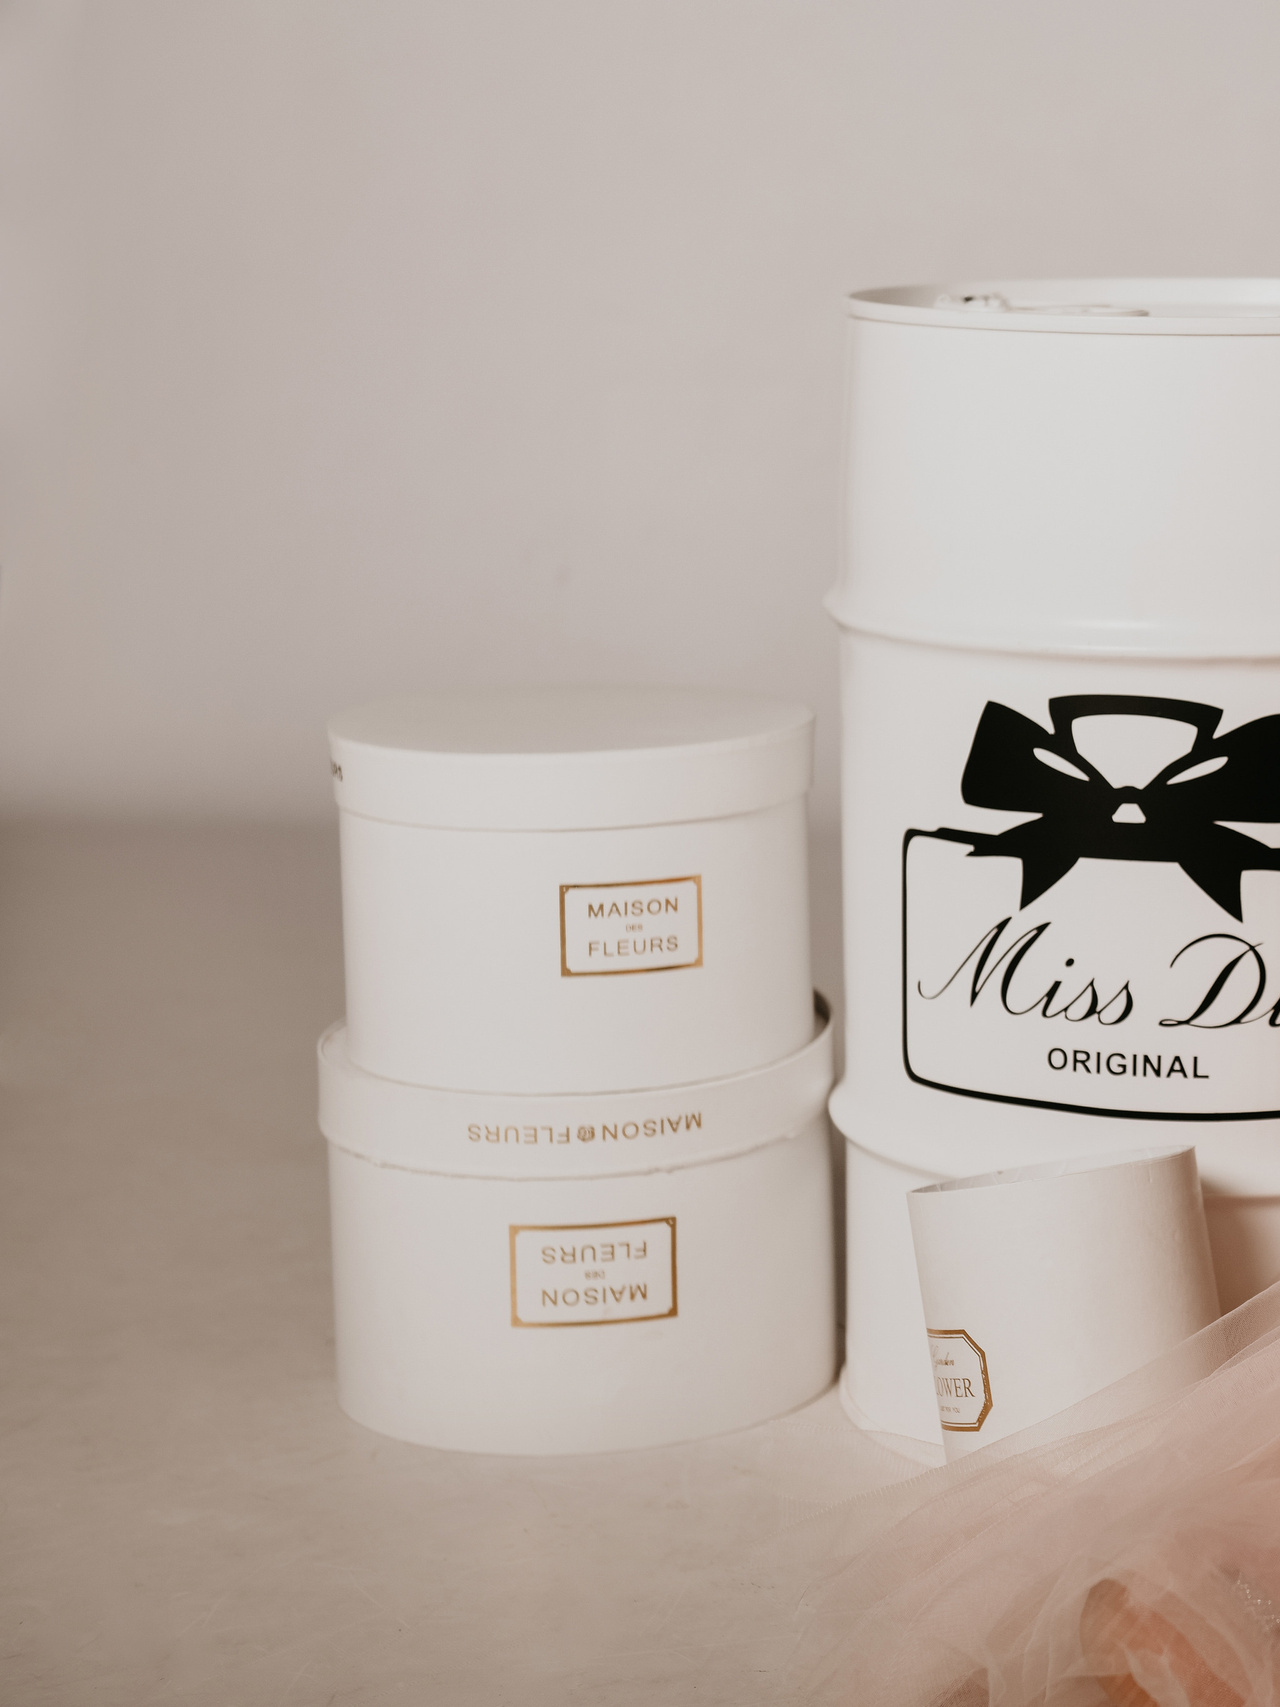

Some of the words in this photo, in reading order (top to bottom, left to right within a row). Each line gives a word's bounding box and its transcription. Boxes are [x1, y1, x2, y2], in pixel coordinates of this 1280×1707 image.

[588, 897, 678, 918] MAISON
[588, 936, 679, 957] FLEURS
[918, 916, 1135, 1026] Miss
[1047, 1047, 1211, 1080] ORIGINAL
[466, 1123, 571, 1145] FLEURS
[601, 1111, 703, 1143] MAISON
[541, 1240, 648, 1265] FLEURS
[541, 1283, 648, 1308] MAISON
[934, 1376, 976, 1398] OWER
